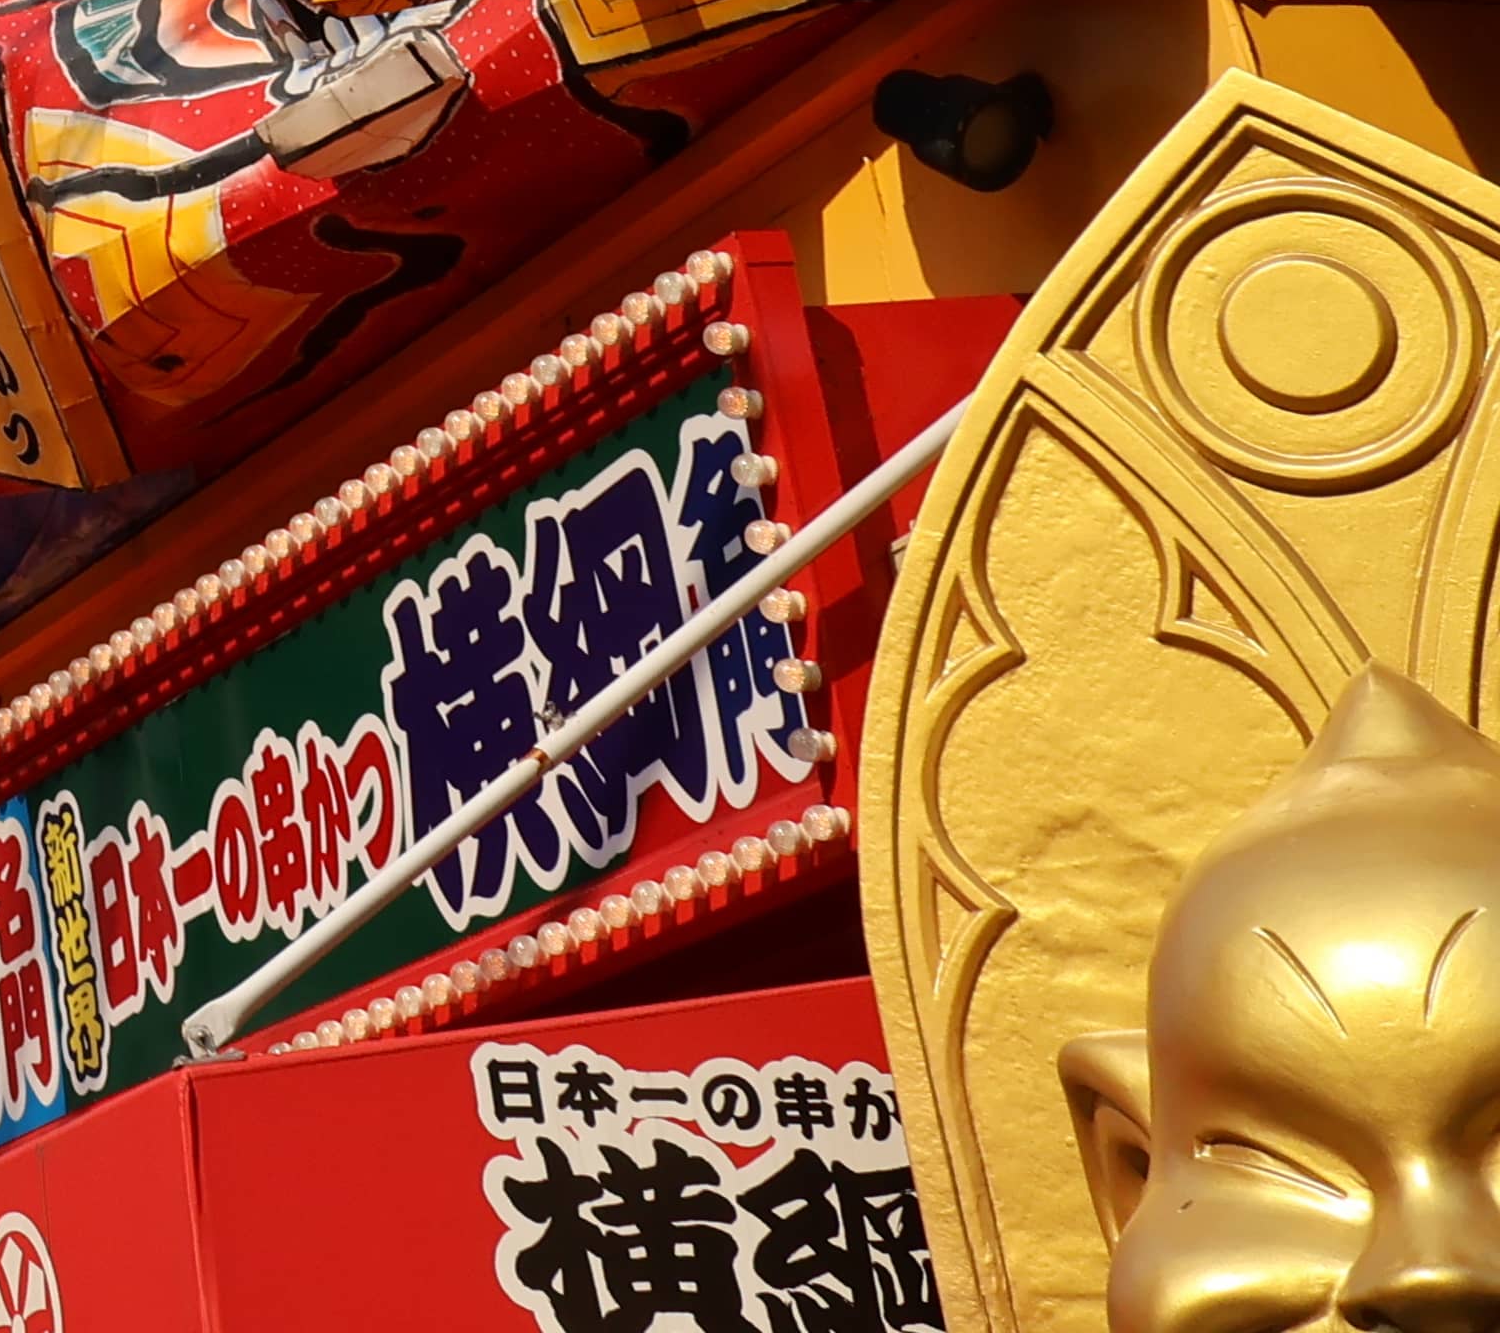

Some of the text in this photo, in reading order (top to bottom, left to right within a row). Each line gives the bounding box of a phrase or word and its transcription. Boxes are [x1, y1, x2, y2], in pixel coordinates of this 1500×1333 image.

[390, 469, 702, 915] 横綱
[46, 811, 101, 1077] 新世界
[98, 732, 393, 1001] 日本一の串かつ
